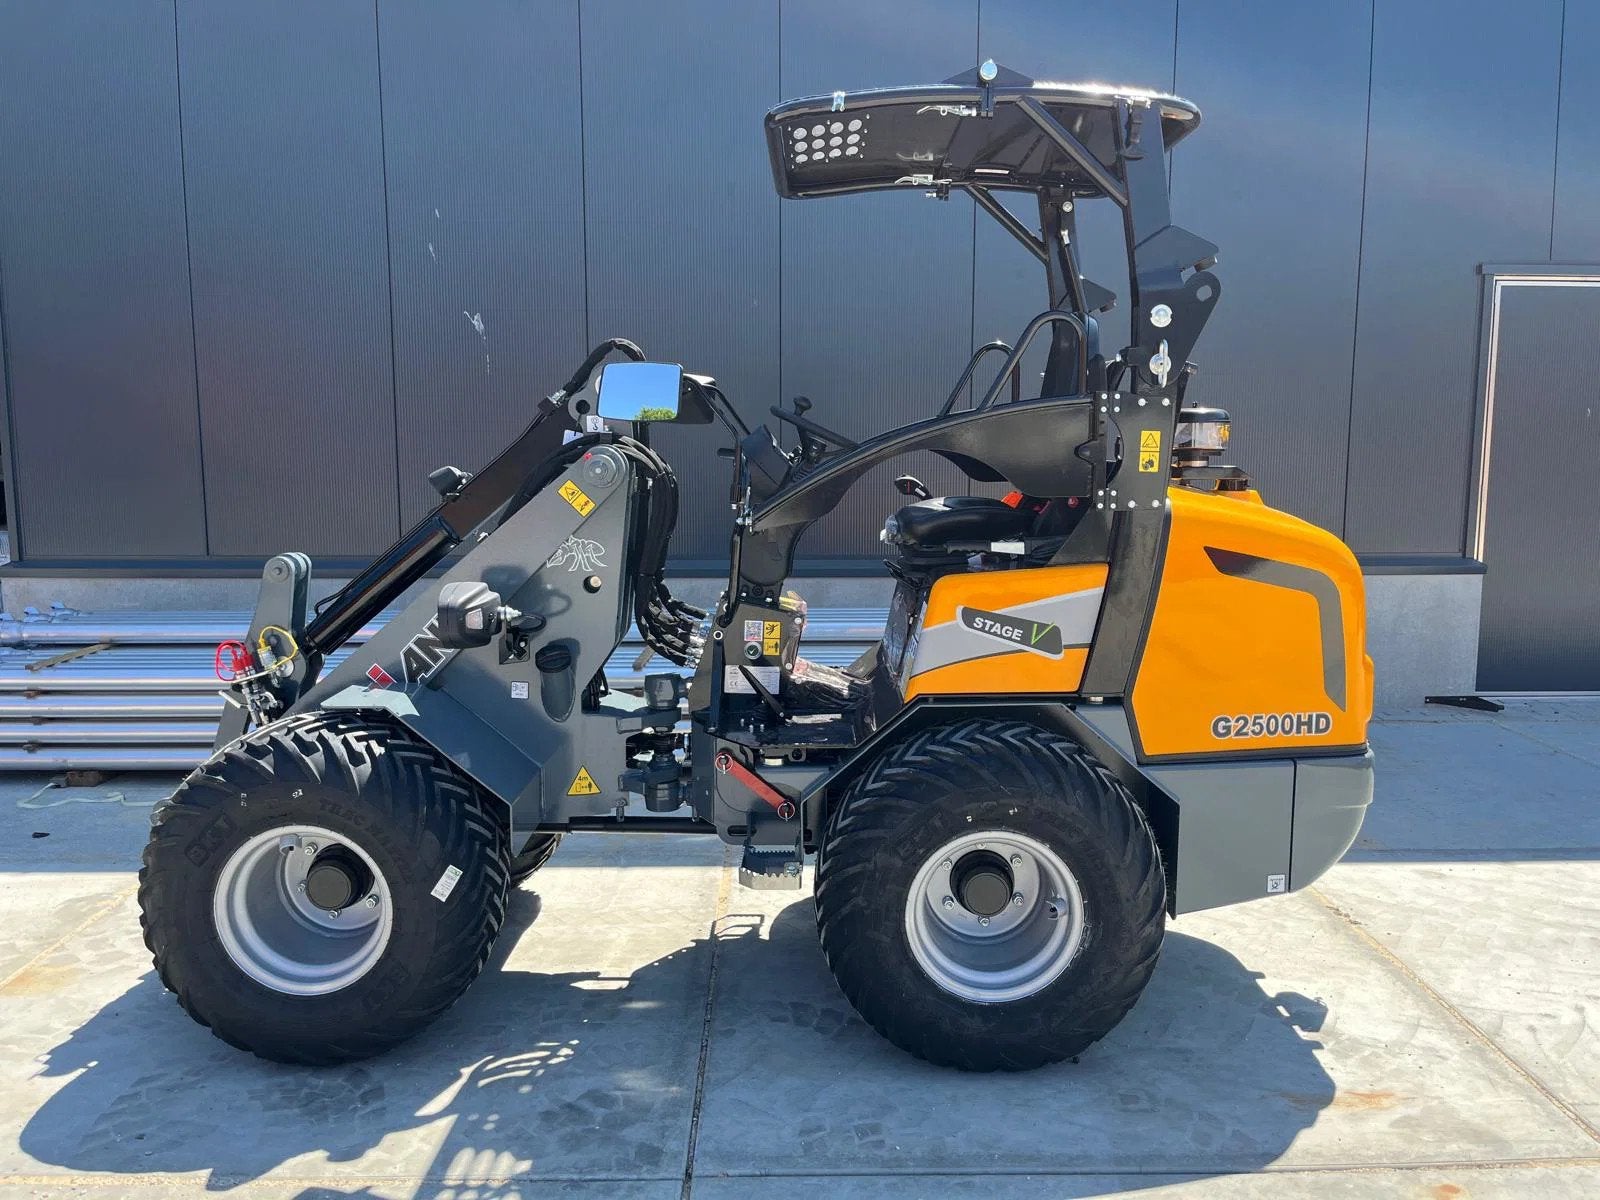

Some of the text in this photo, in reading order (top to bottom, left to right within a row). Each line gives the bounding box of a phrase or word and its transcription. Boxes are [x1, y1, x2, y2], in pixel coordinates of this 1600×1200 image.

[973, 616, 1056, 645] STAGE V
[1211, 711, 1332, 739] G2500HD
